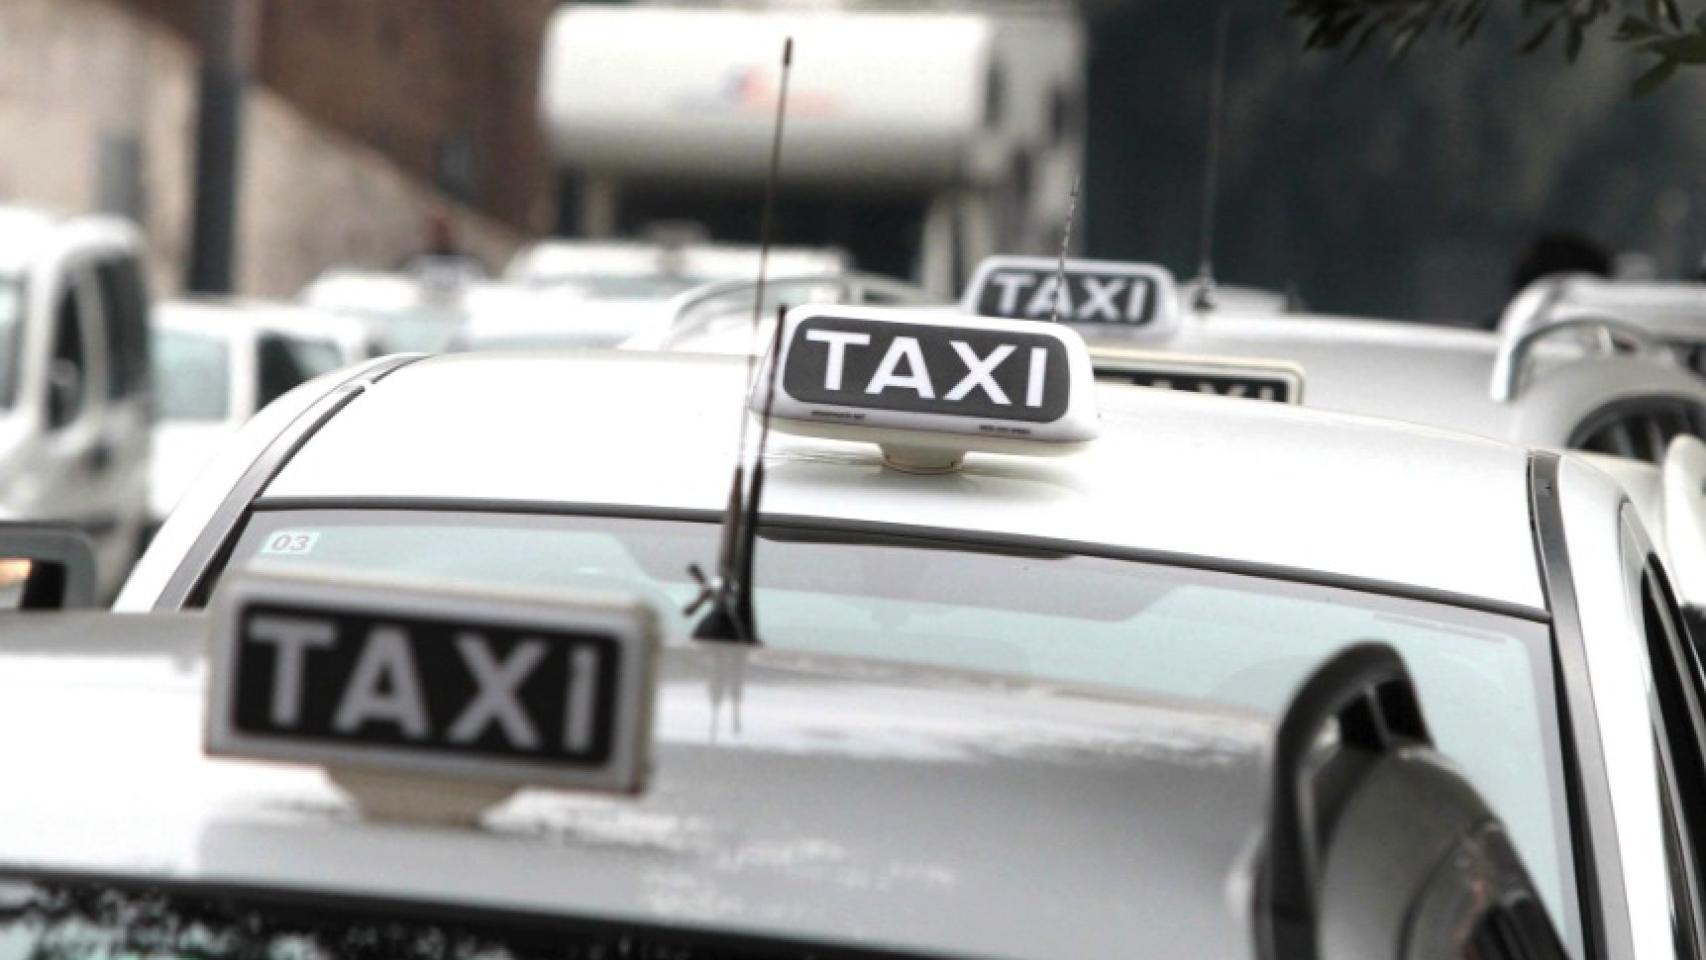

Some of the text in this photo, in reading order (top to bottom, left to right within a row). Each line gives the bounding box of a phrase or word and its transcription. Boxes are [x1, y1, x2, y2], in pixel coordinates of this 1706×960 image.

[992, 272, 1148, 322] TAXI
[806, 329, 1048, 407] TAXI
[271, 533, 310, 551] 03
[249, 616, 598, 753] TAXI
